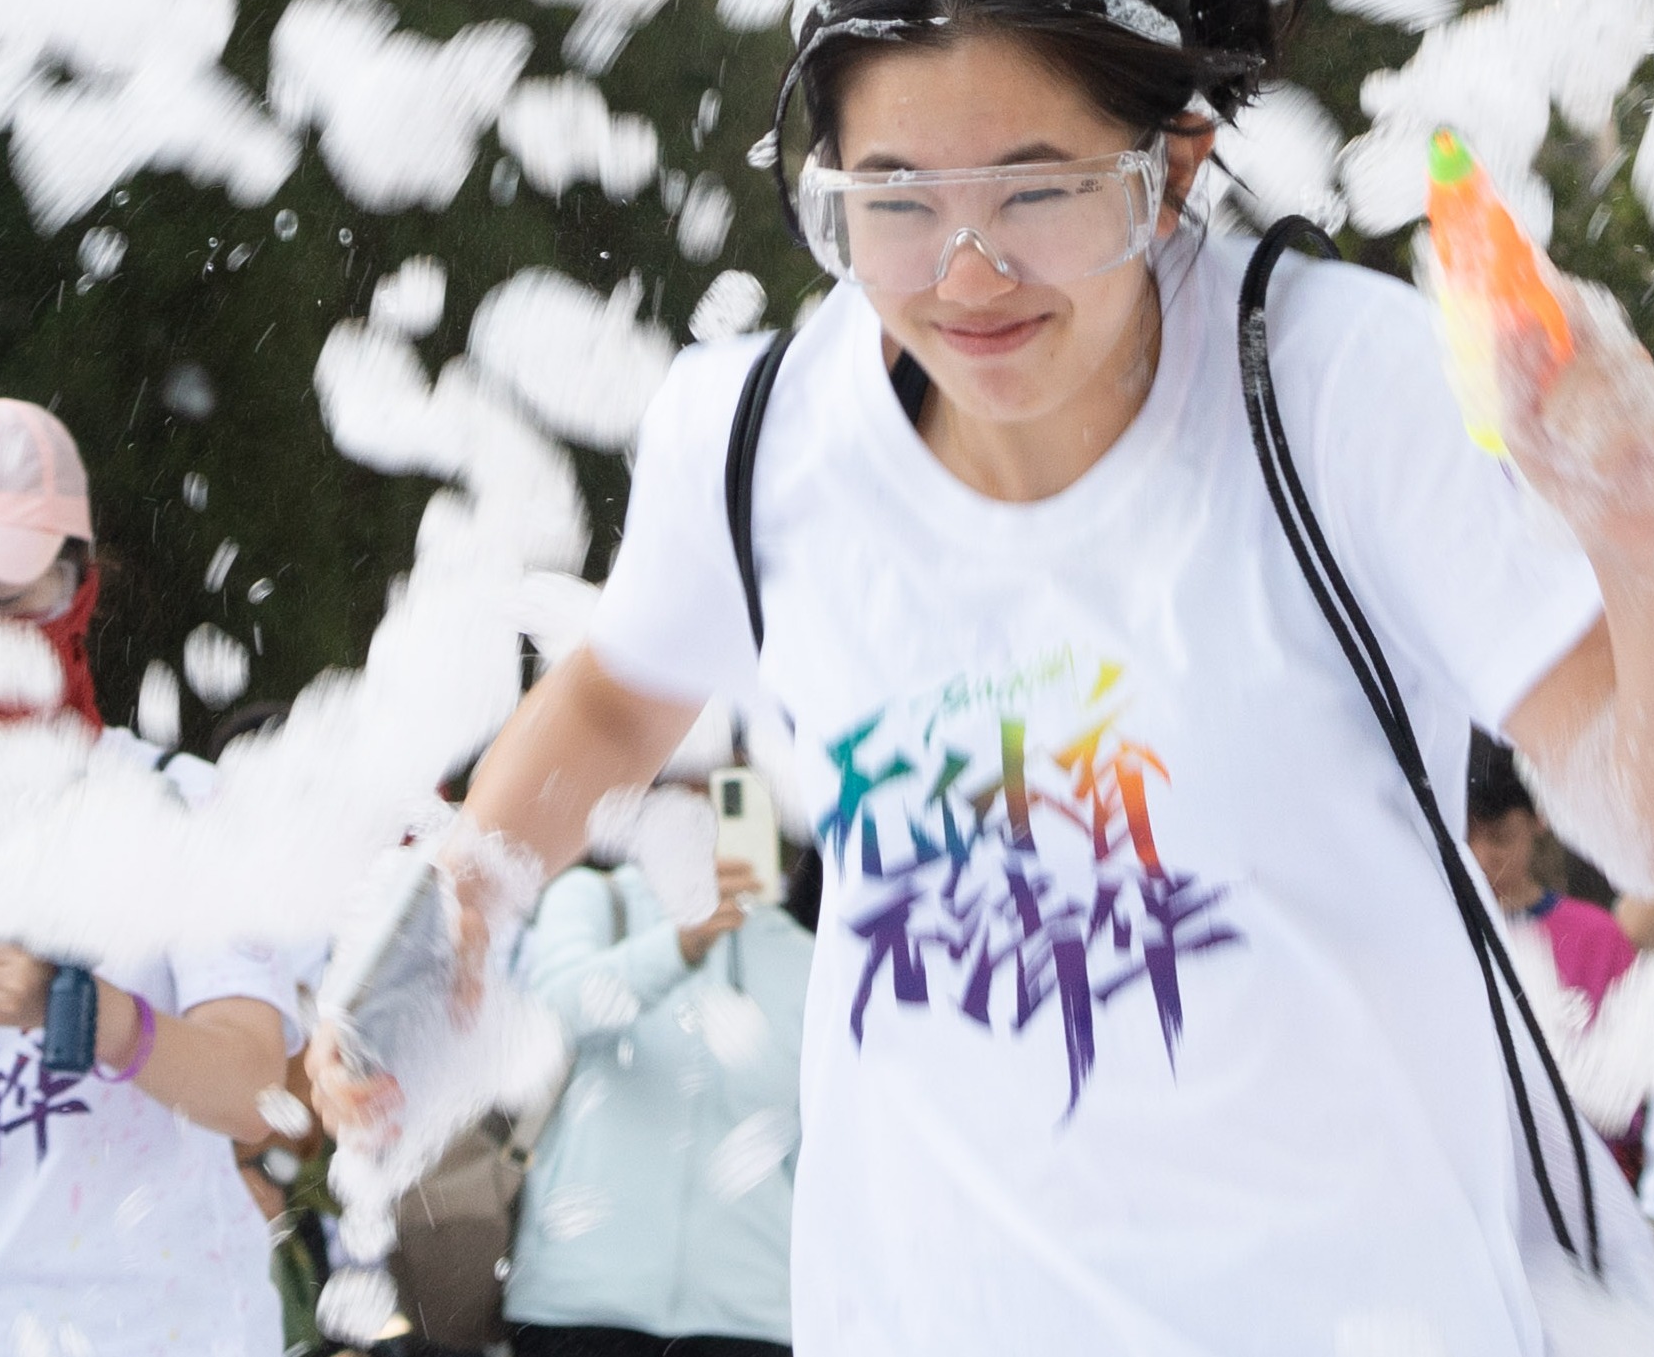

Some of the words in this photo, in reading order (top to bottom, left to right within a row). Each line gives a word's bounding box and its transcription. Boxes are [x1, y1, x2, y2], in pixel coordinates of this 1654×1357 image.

[818, 661, 1173, 899] 无体育
[846, 851, 1248, 1124] 不清华
